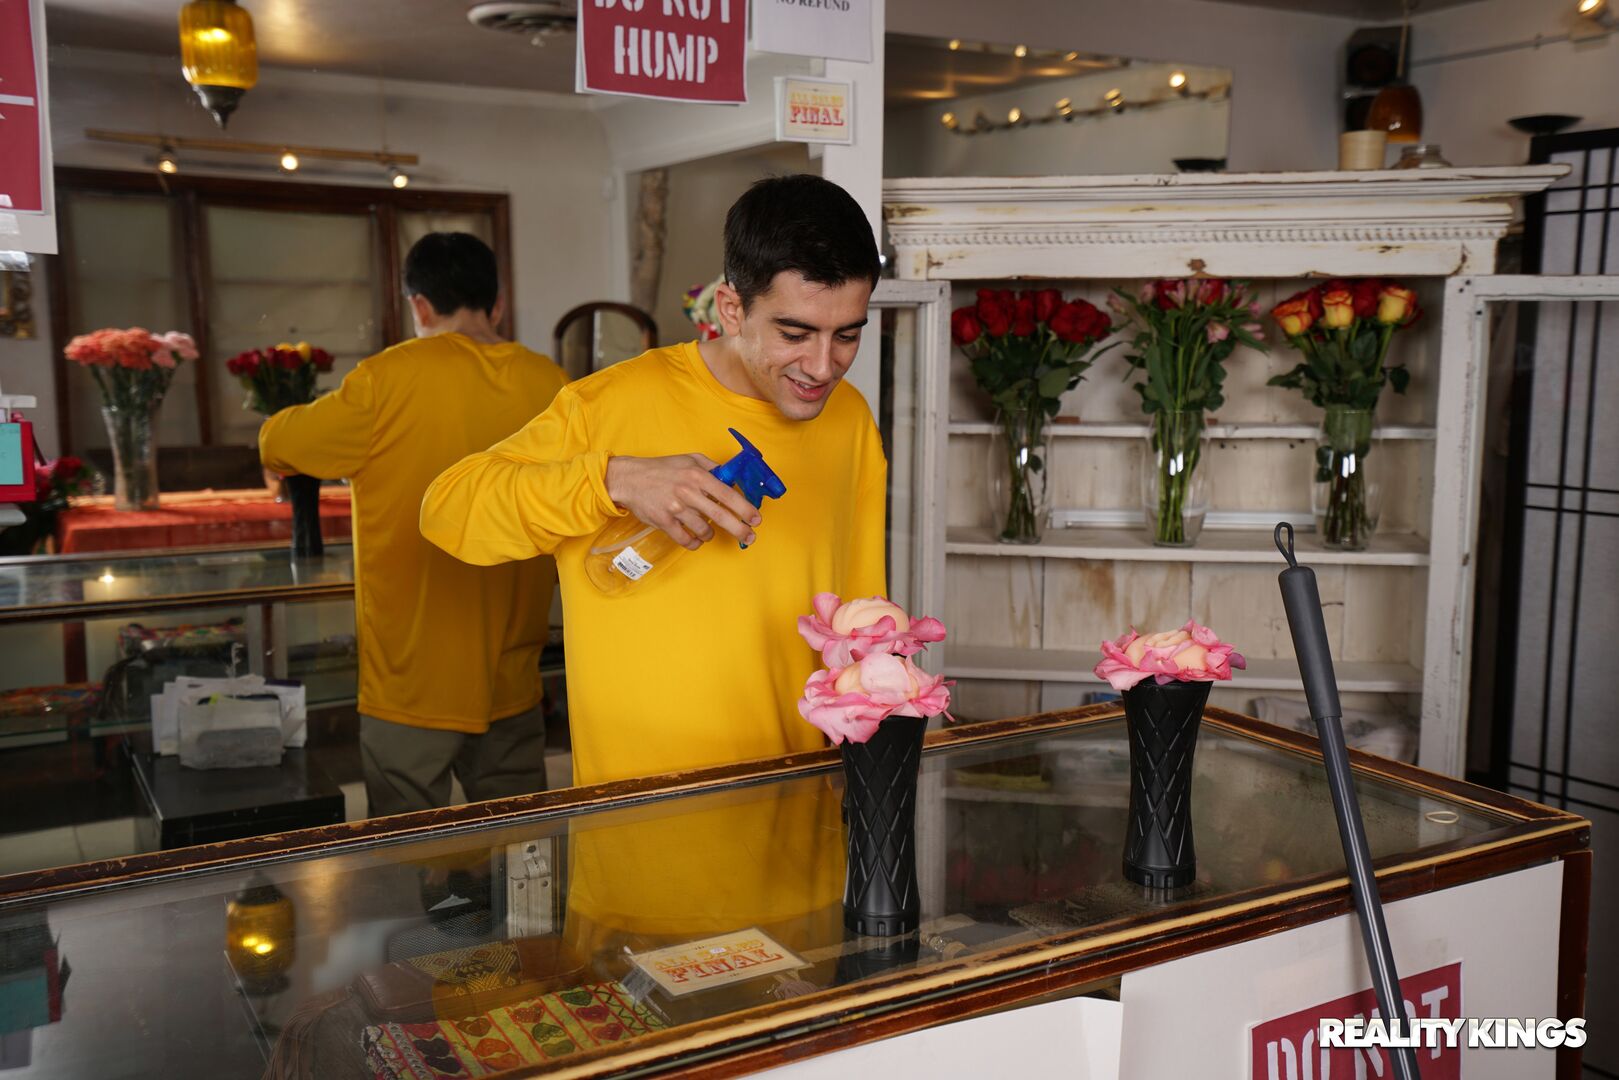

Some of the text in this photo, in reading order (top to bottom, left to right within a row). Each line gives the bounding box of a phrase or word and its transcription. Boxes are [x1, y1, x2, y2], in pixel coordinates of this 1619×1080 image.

[799, 0, 850, 11] REFUND
[614, 25, 718, 84] HUMP
[662, 948, 784, 983] FINAL
